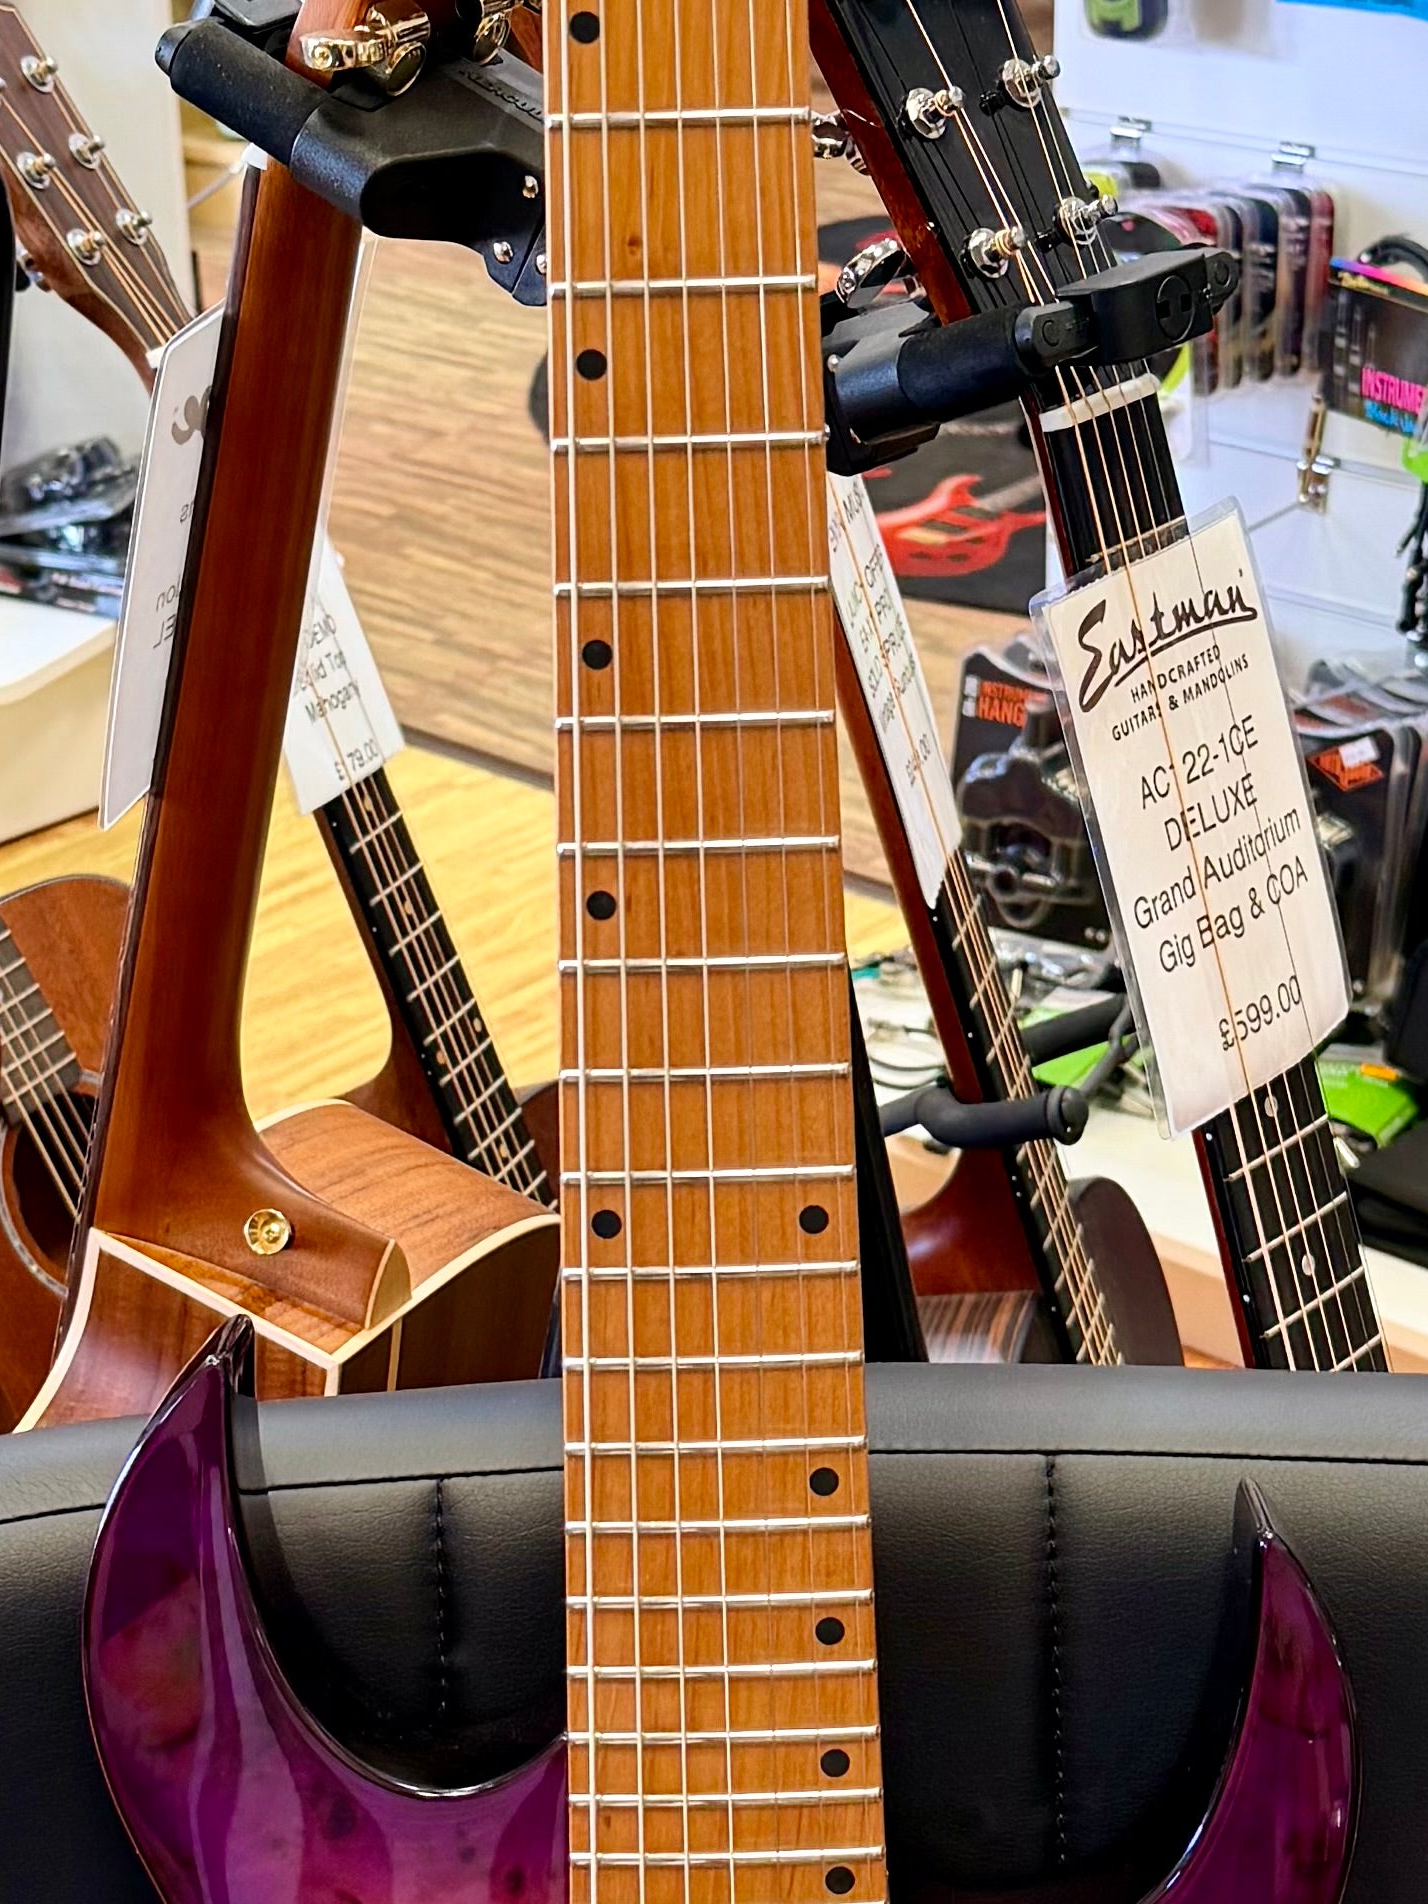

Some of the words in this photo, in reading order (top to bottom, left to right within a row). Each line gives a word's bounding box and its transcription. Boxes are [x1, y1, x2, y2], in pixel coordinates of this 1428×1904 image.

[1077, 582, 1259, 714] Eastman
[1130, 643, 1222, 704] HANDCRAFTED
[977, 695, 1027, 730] HANG
[1111, 700, 1163, 742] GUITARS
[1168, 694, 1180, 712] &
[1182, 652, 1250, 706] MANDOLINS
[333, 738, 380, 781] £79.00
[1140, 713, 1260, 811] AC22-1CE
[1164, 772, 1259, 852] DELUXE
[1133, 864, 1198, 930] Grand
[1201, 807, 1302, 891] Auditorium
[1158, 931, 1197, 974] Gig
[1195, 903, 1246, 950] Bag
[1248, 886, 1267, 921] &
[1265, 854, 1310, 907] COA
[1217, 973, 1303, 1053] £599.00
